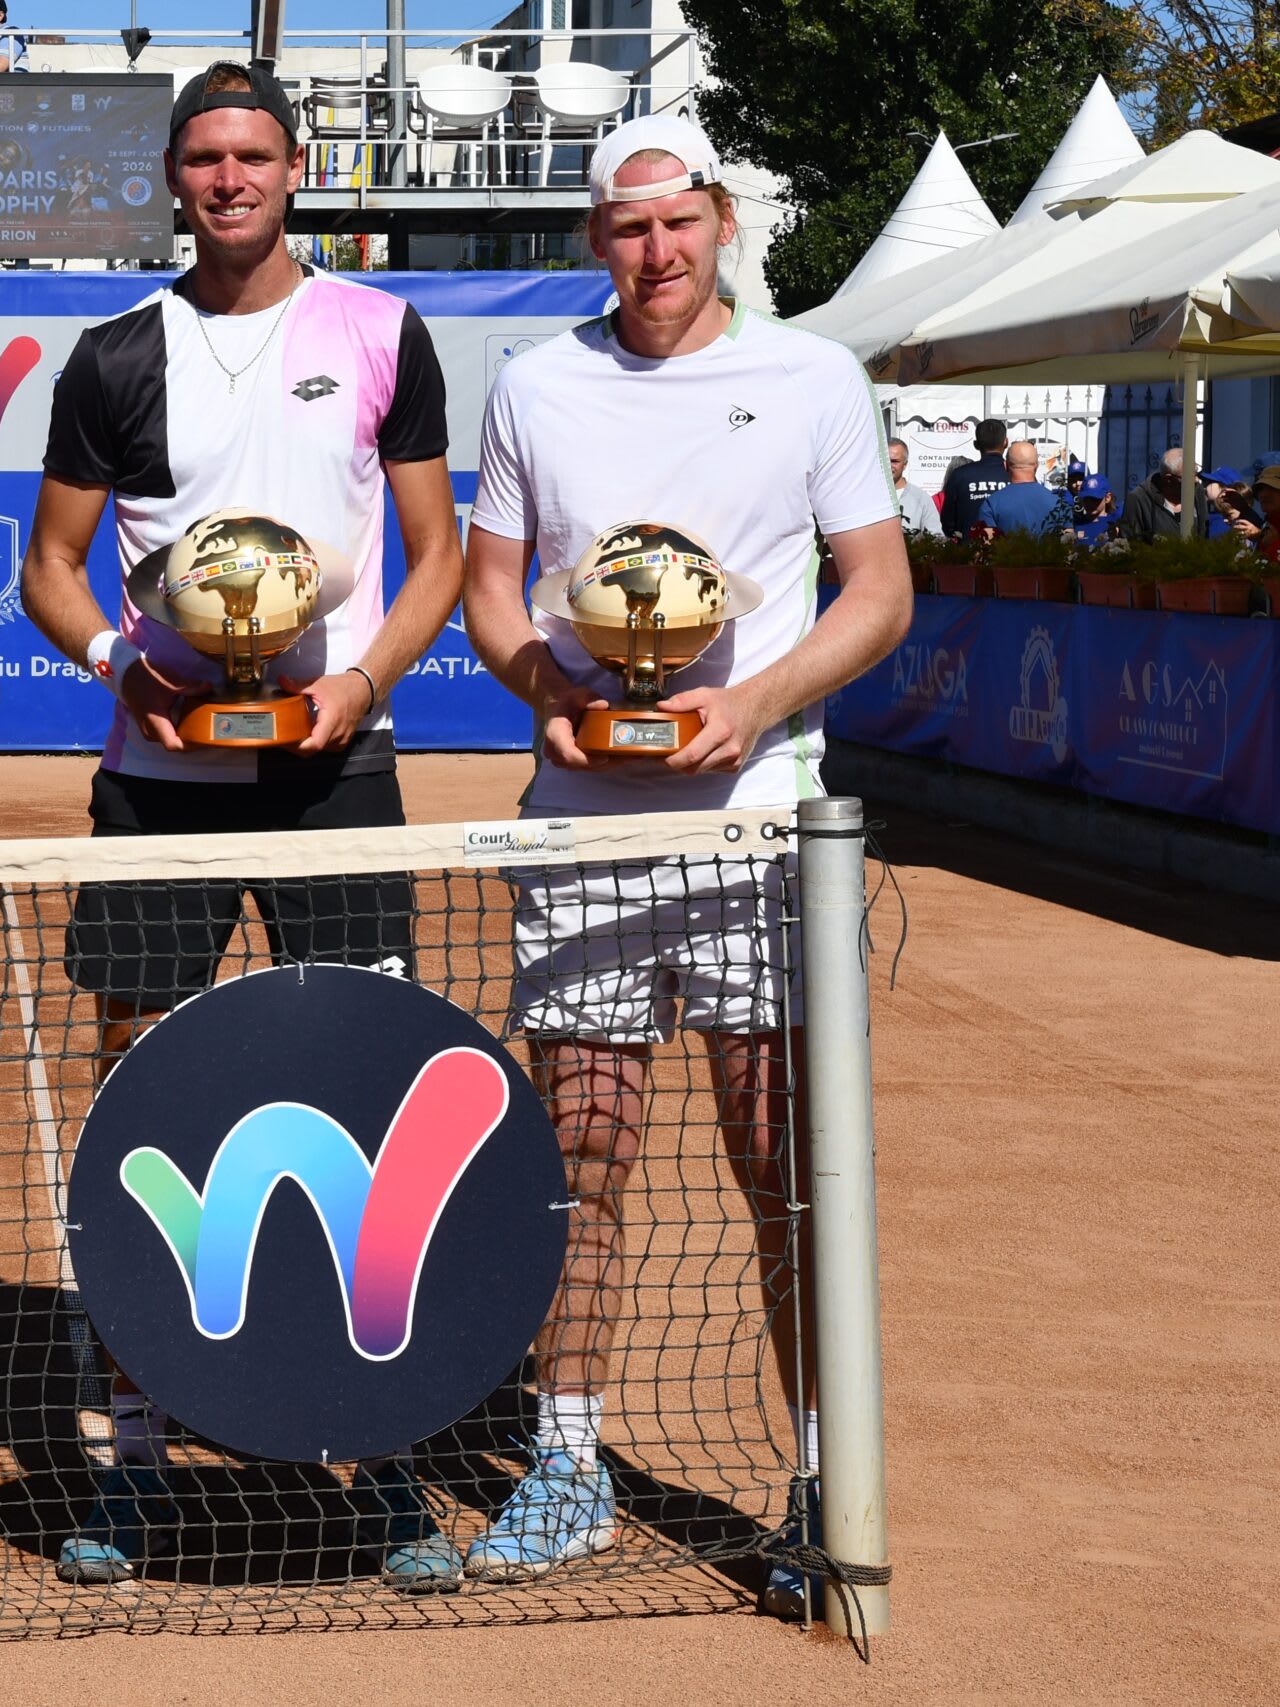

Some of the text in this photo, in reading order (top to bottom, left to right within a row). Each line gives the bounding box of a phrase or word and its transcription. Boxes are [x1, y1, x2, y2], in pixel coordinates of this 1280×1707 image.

[42, 124, 92, 133] FUTURES
[121, 161, 153, 171] 2026
[892, 641, 968, 703] AZUGA
[469, 831, 547, 853] Court Royal
